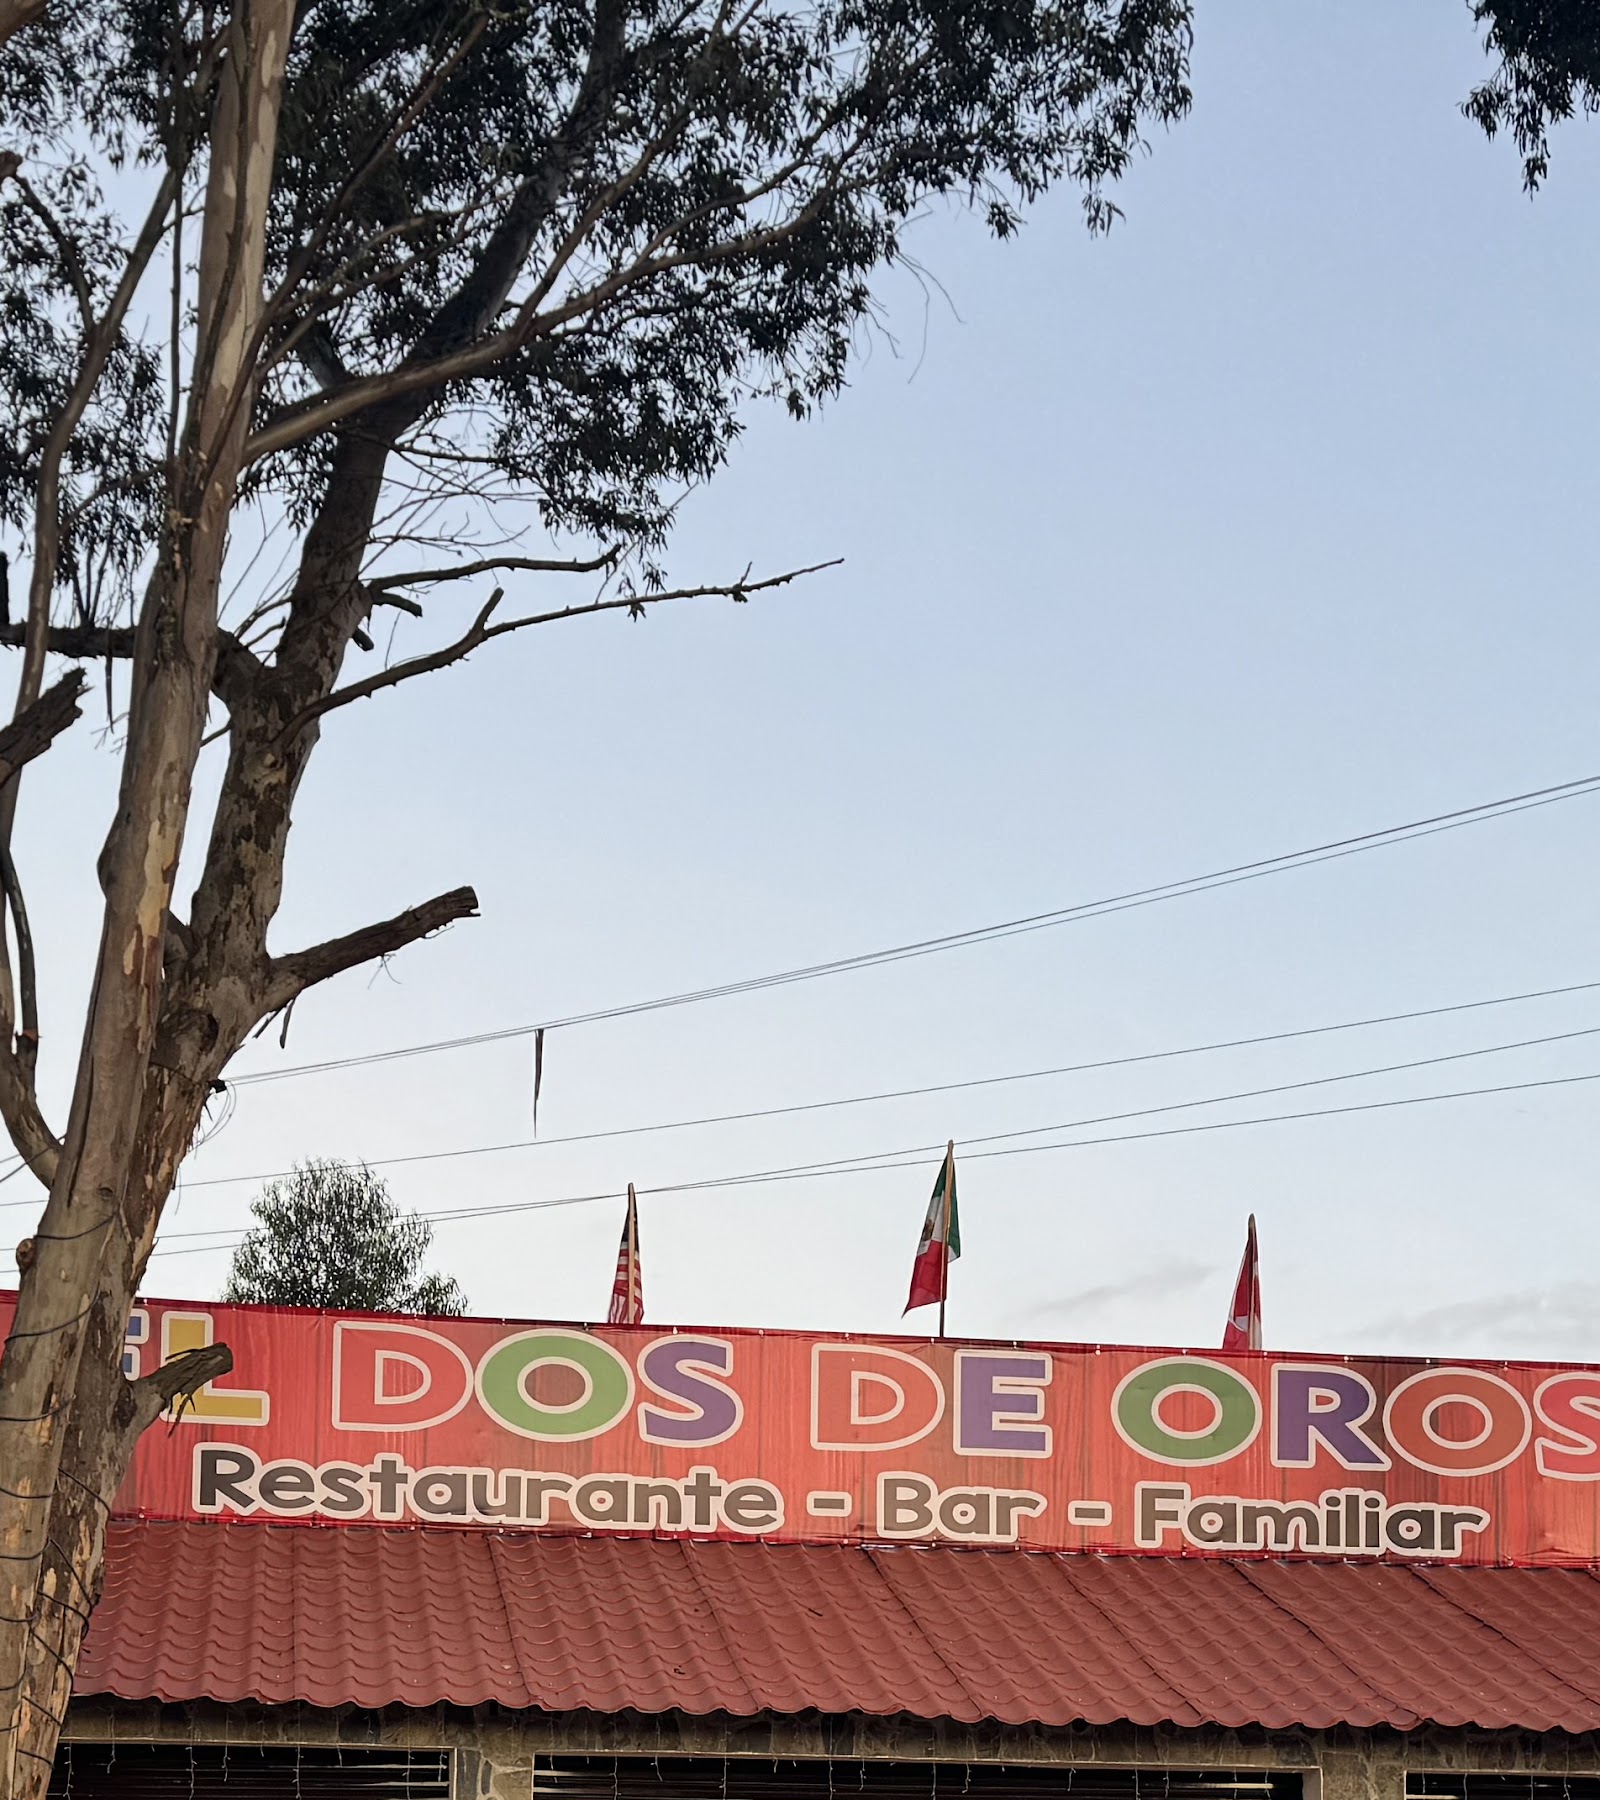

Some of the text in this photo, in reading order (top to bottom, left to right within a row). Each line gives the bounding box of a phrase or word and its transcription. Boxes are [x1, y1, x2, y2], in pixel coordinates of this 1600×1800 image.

[331, 1320, 744, 1449] DOS
[810, 1342, 1054, 1460] DE
[192, 1443, 784, 1532] Restaurante
[876, 1471, 1048, 1543] Bar
[1135, 1480, 1491, 1558] Familiar
